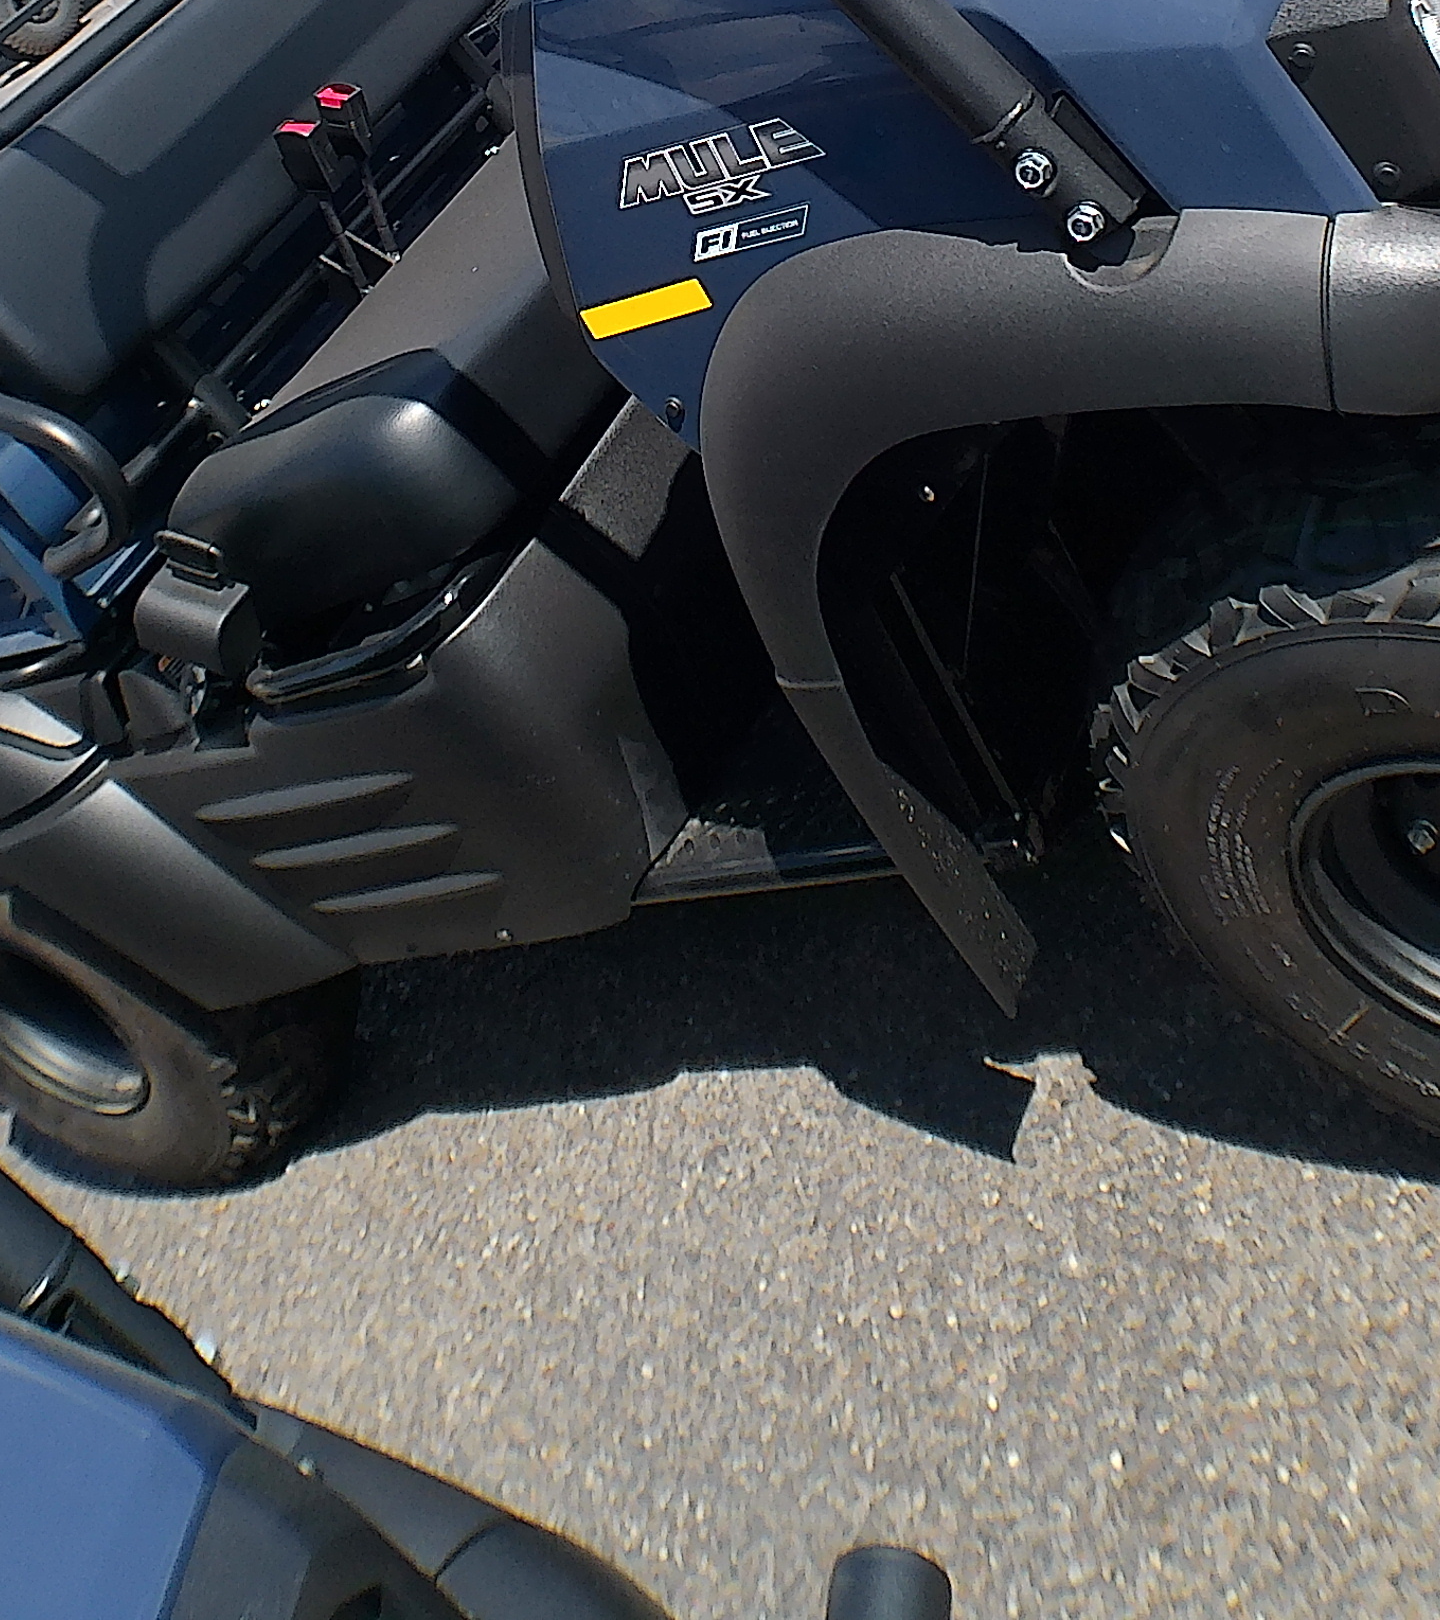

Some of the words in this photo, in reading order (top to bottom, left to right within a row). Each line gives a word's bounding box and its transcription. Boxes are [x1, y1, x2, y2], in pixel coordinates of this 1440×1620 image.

[618, 117, 827, 210] MULE
[682, 175, 772, 215] SX
[698, 227, 736, 257] FI
